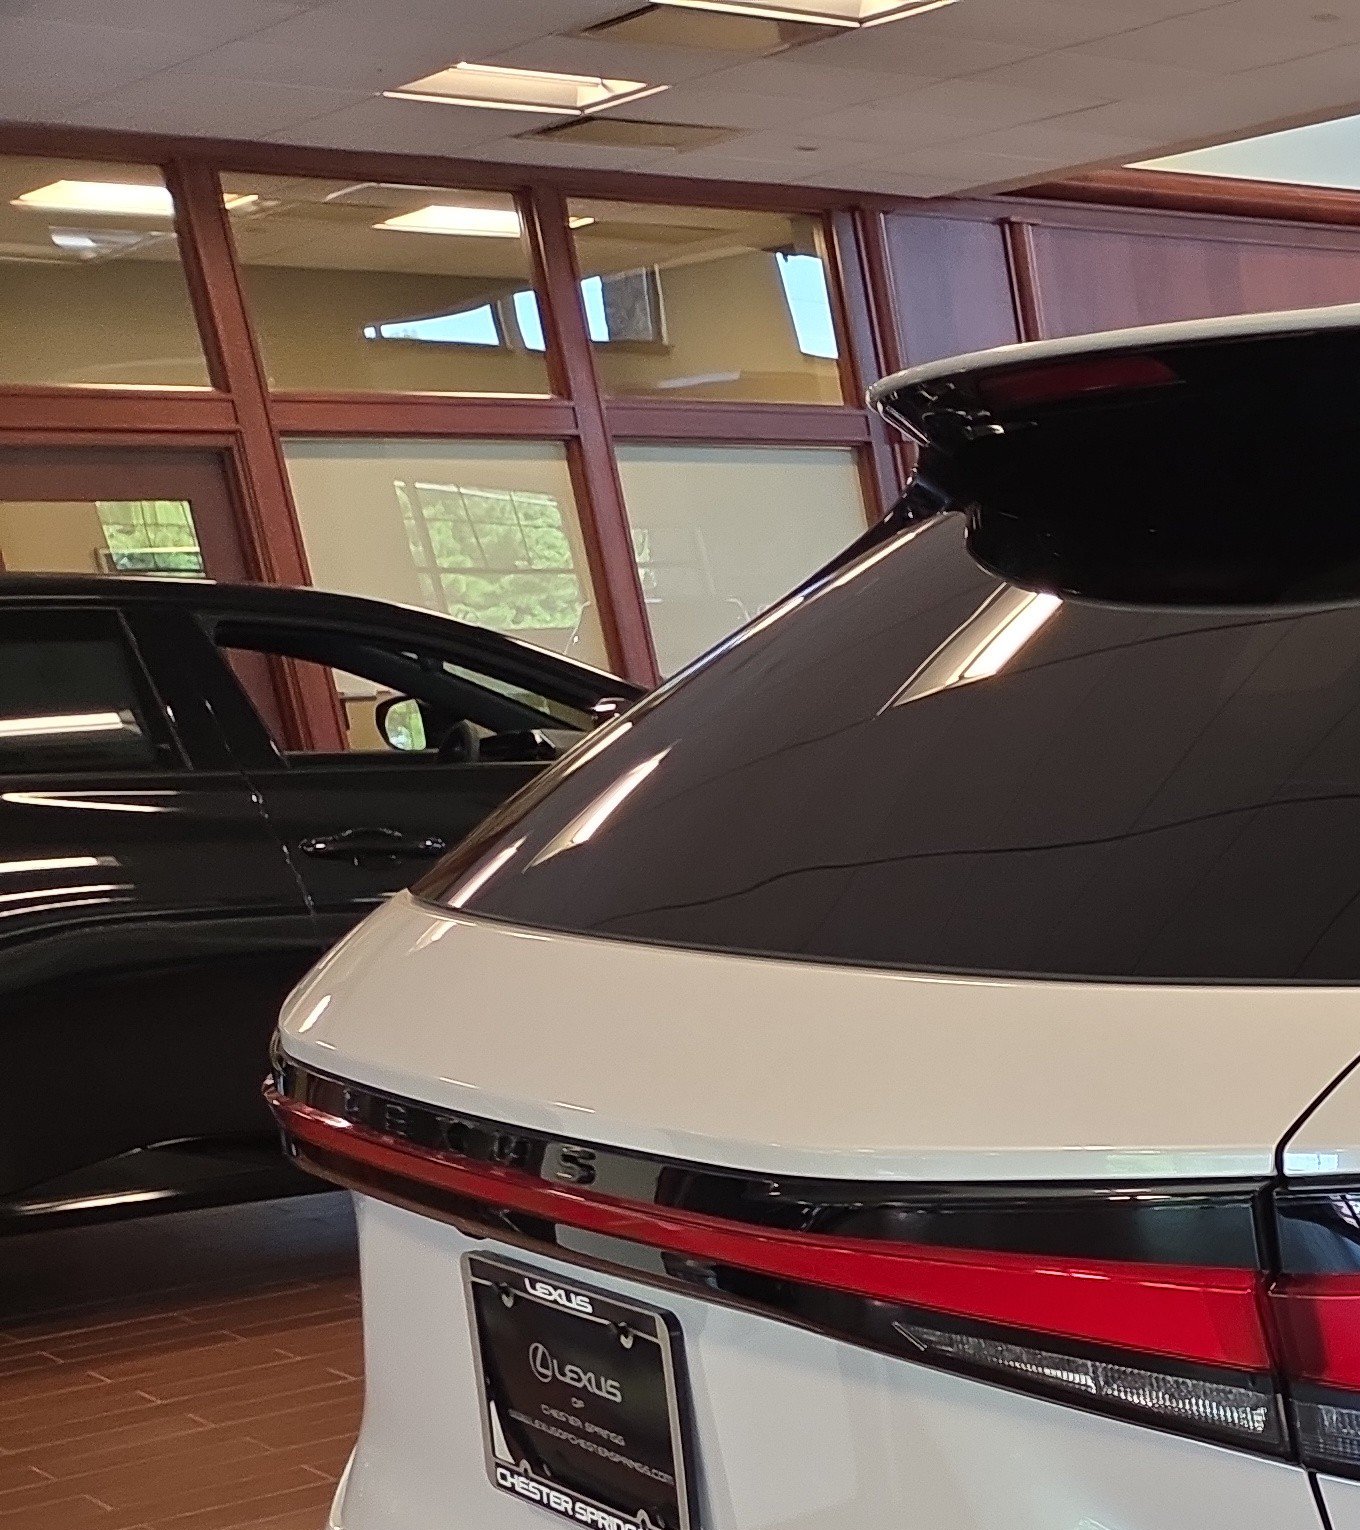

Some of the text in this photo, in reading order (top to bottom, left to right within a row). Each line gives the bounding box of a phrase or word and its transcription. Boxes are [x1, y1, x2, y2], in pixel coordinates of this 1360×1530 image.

[524, 1277, 593, 1314] LEXUS
[552, 1358, 622, 1403] LEXUS
[496, 1466, 574, 1516] CHESTER
